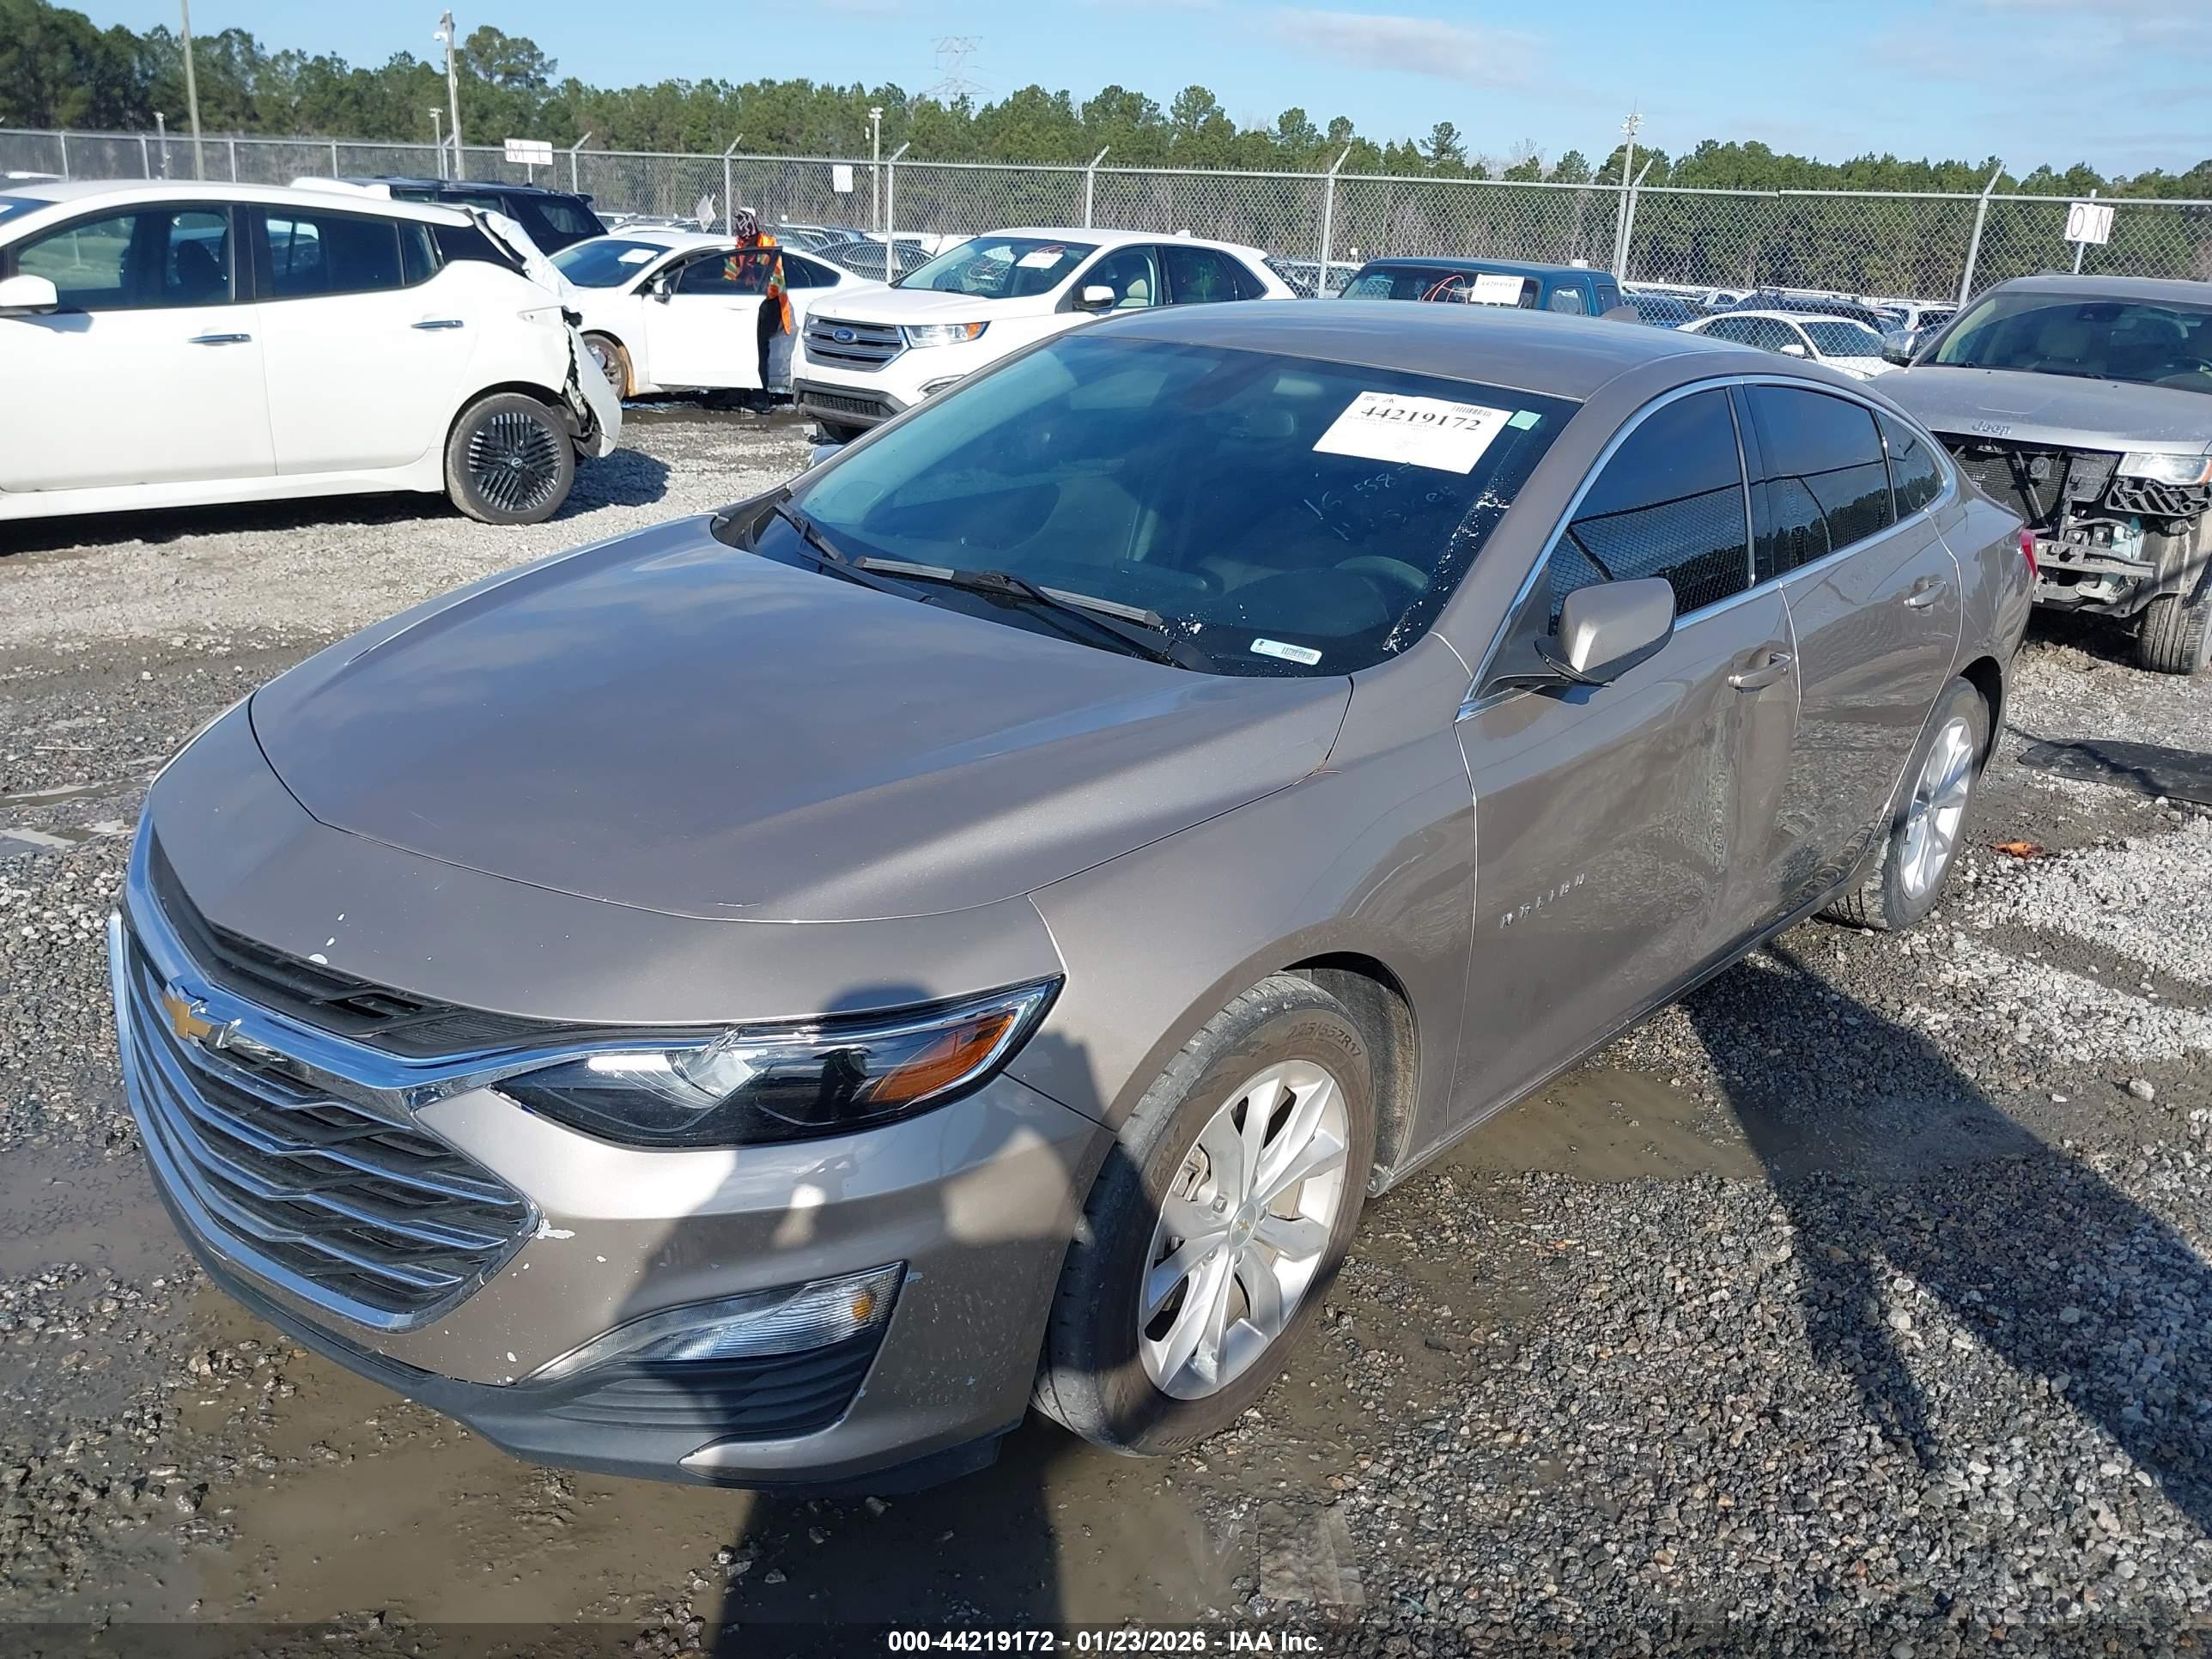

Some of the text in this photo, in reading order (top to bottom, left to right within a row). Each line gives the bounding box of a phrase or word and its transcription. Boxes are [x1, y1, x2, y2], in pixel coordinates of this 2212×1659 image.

[2093, 208, 2111, 241] N
[1360, 405, 1483, 431] 44219172
[1972, 421, 2011, 435] Jeep
